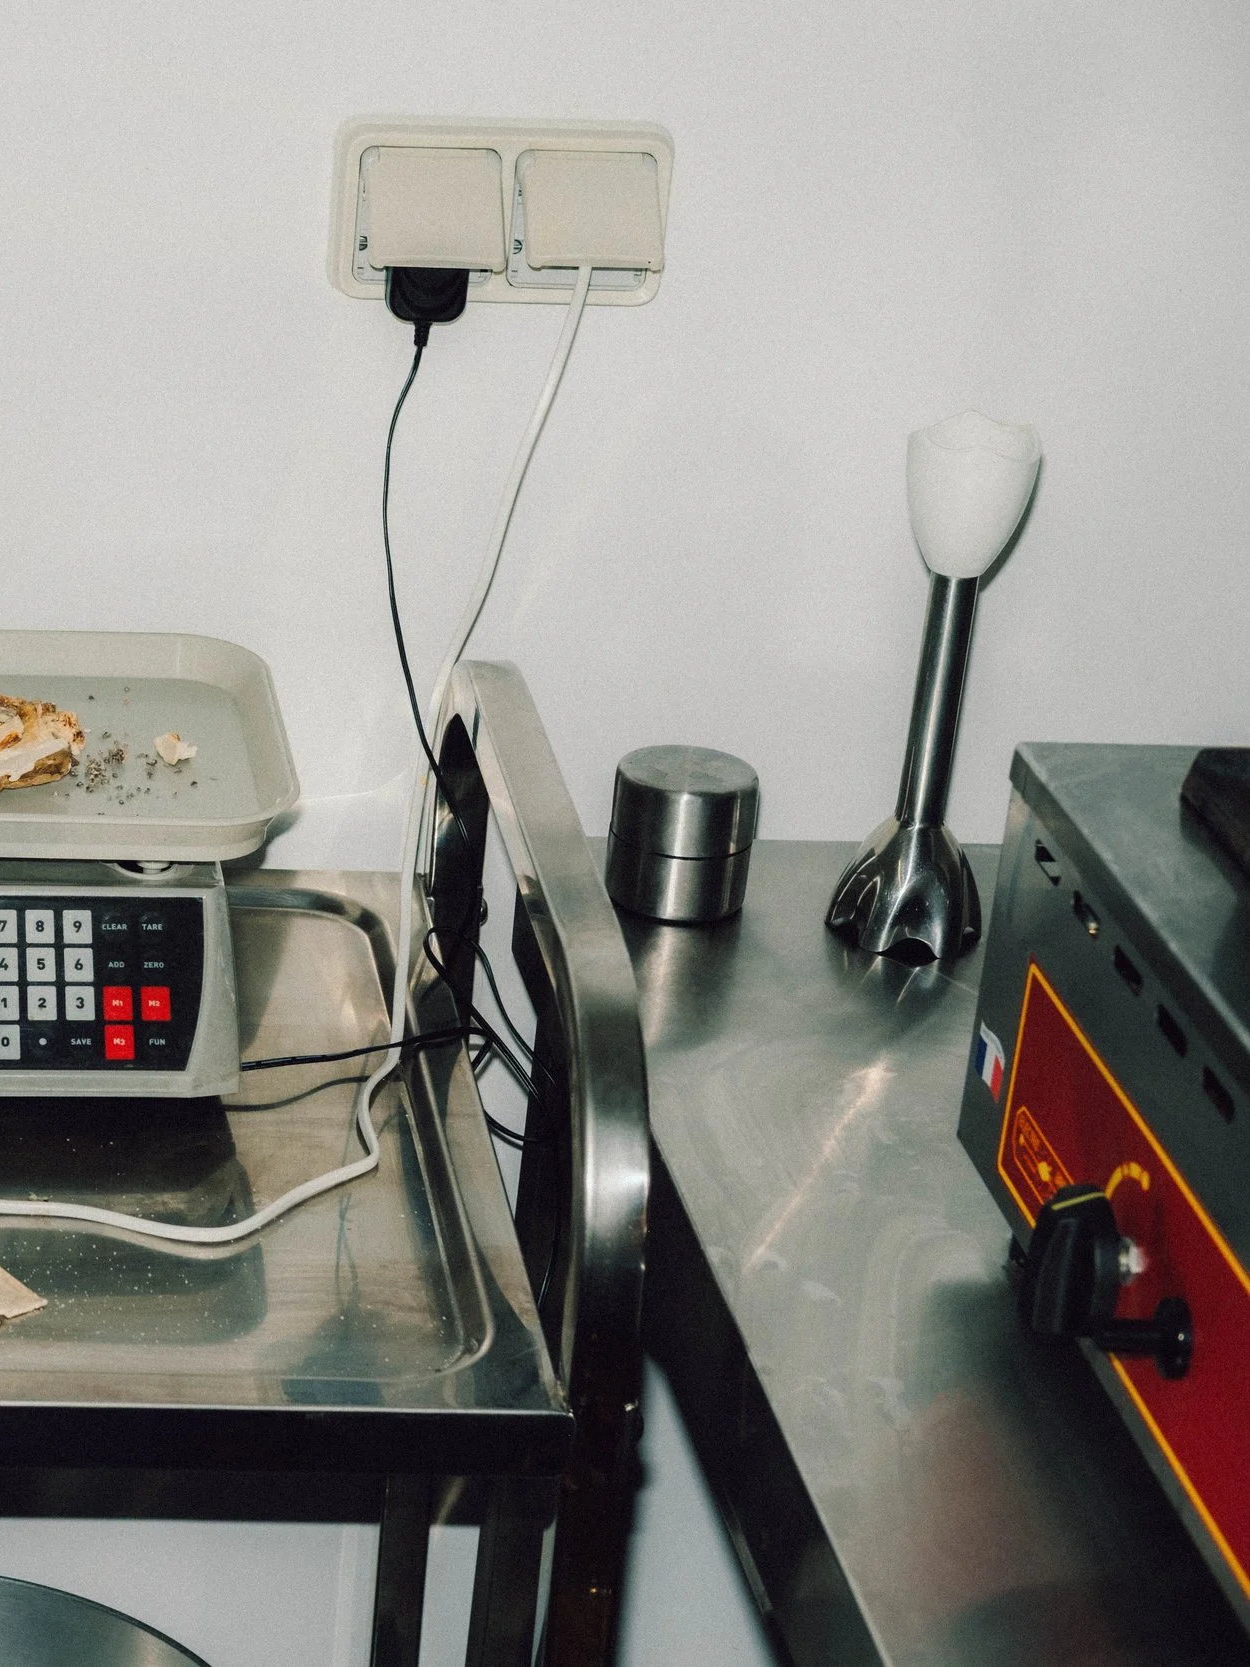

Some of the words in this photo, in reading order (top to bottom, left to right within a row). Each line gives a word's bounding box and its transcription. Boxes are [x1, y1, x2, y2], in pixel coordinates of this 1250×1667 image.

[35, 919, 45, 933] 8
[72, 920, 83, 934] 9
[101, 923, 128, 931] CLEAR
[141, 923, 163, 931] TARE
[36, 957, 46, 971] 5
[74, 958, 84, 971] 6
[143, 961, 165, 969] ZERO
[0, 997, 8, 1009] 1
[37, 997, 47, 1009] 2
[75, 996, 85, 1010] 3
[111, 999, 124, 1007] M1
[148, 999, 161, 1007] M2
[0, 1036, 10, 1048] 0
[70, 1038, 92, 1046] SAVE
[113, 1037, 126, 1046] M3
[148, 1038, 166, 1046] FUN
